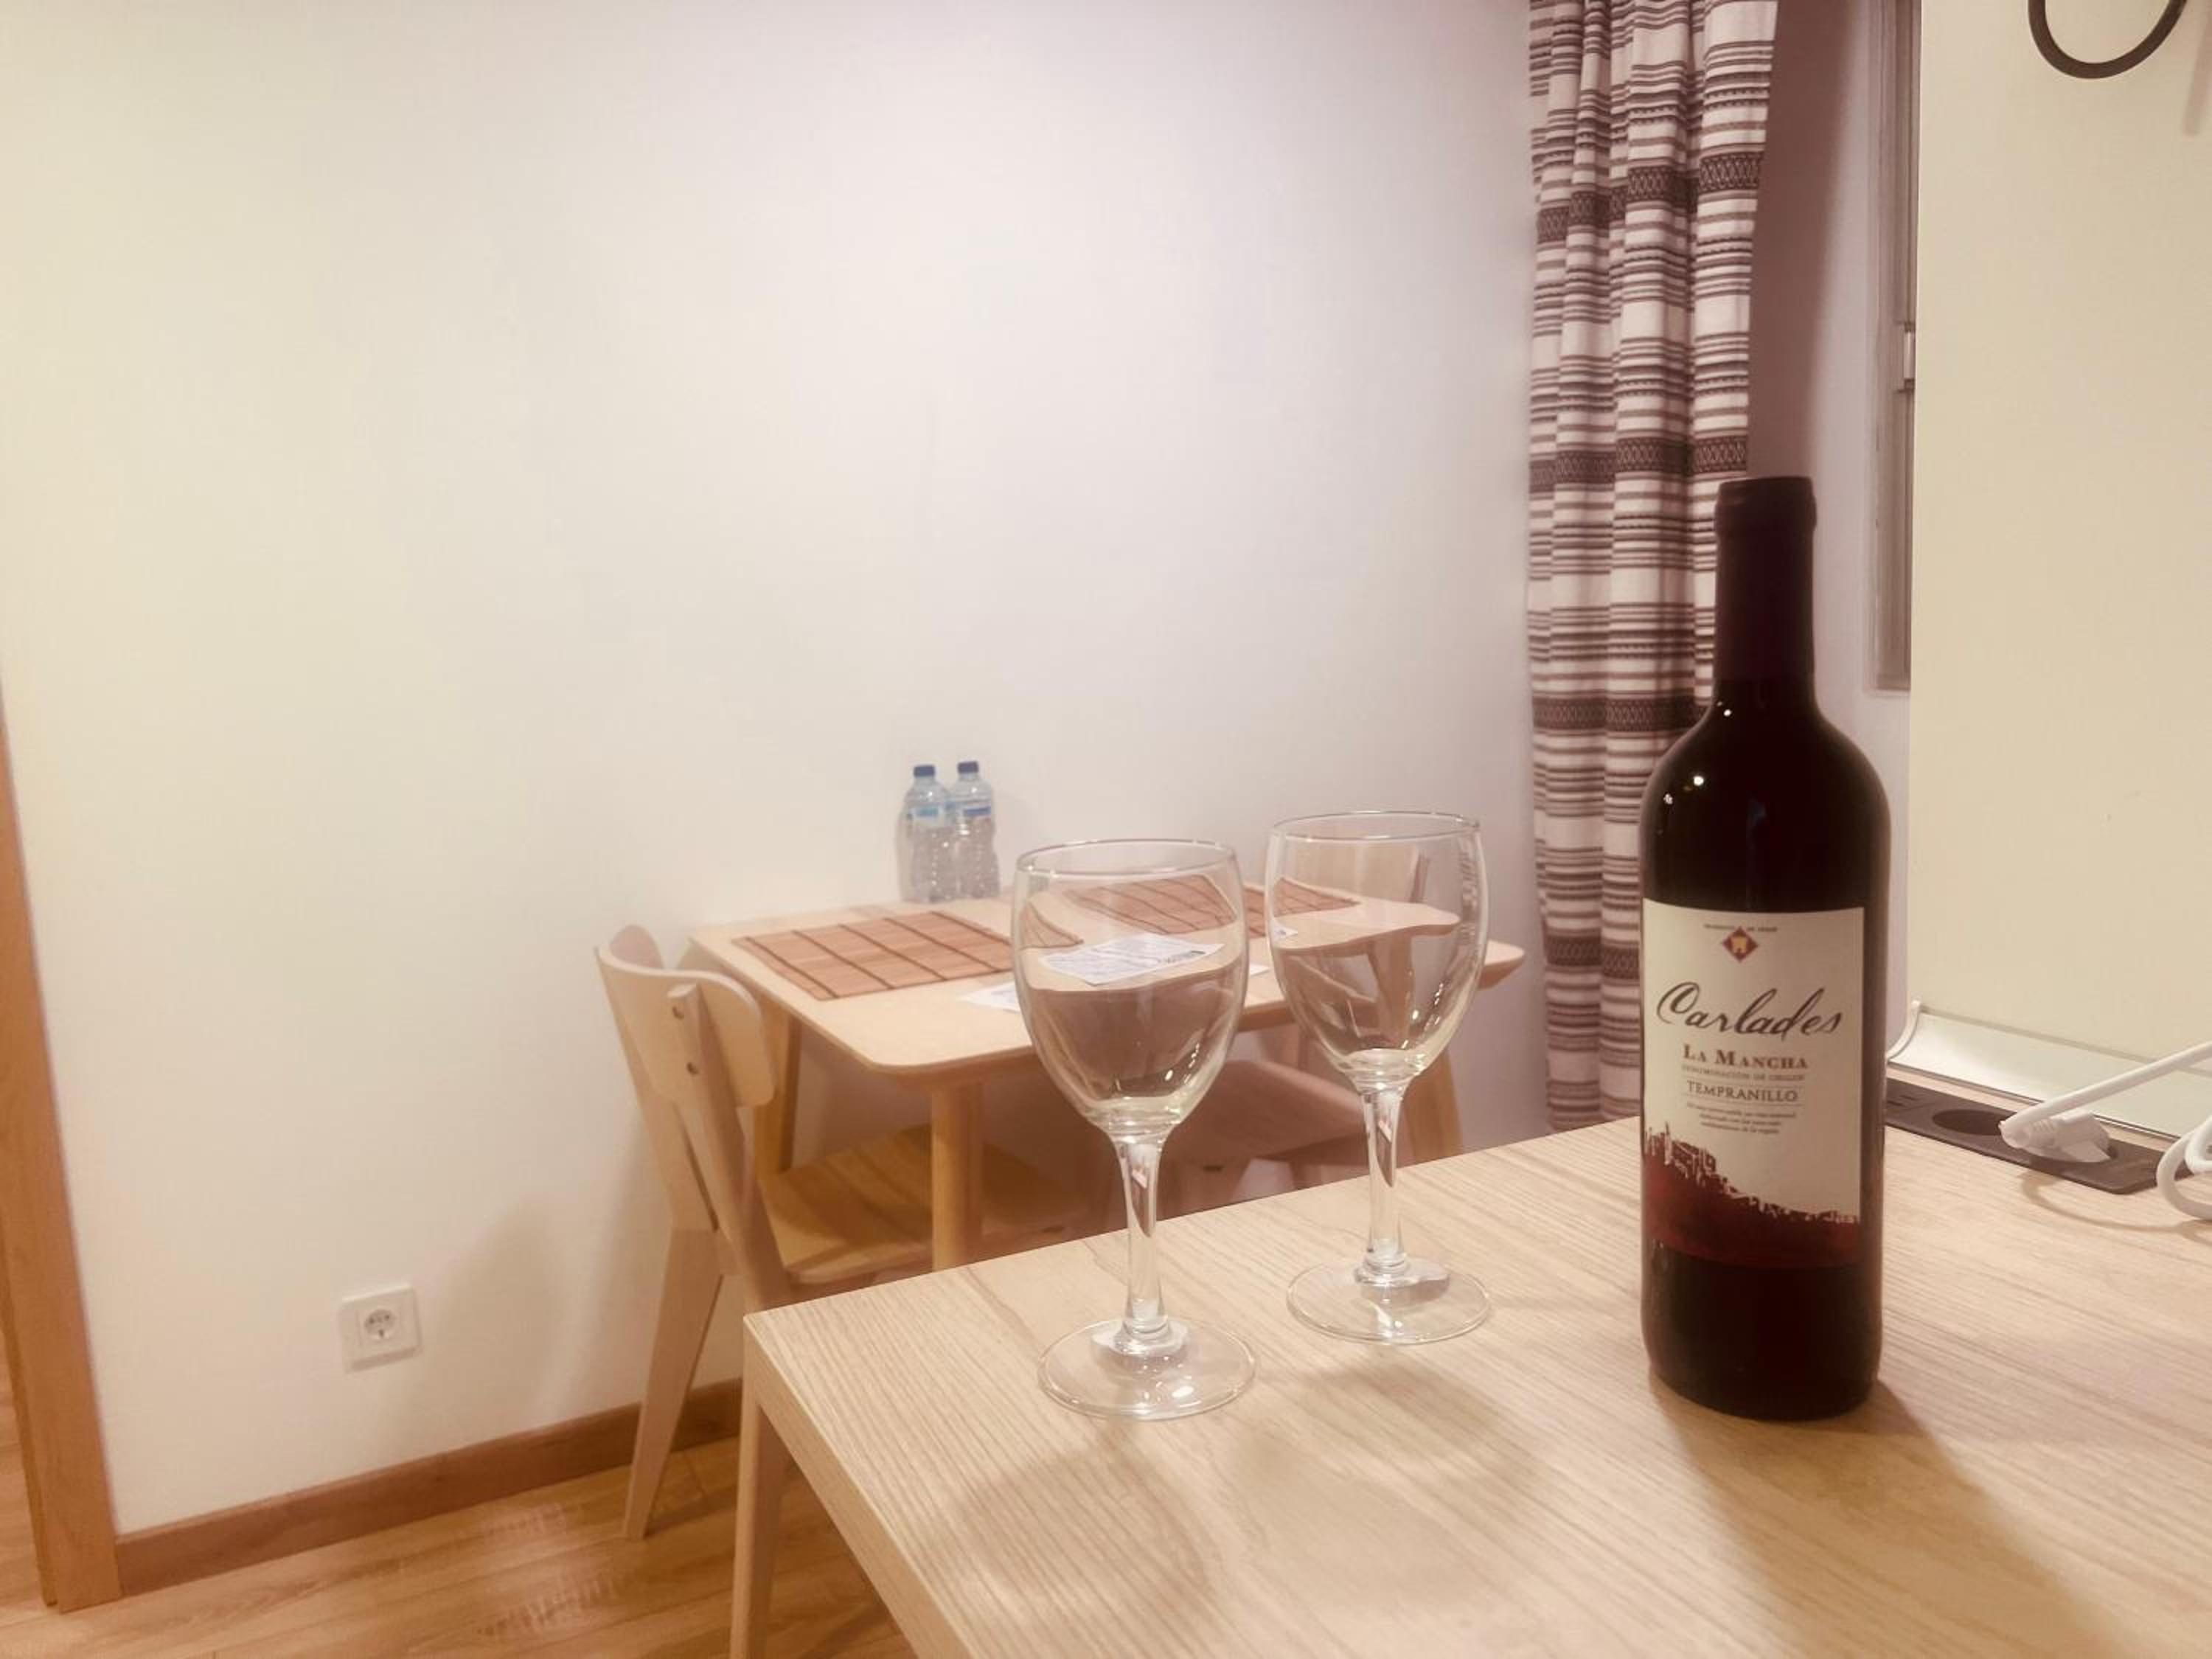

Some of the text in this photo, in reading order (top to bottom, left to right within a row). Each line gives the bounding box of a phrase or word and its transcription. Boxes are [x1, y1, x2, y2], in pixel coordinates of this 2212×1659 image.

[1657, 981, 1841, 1041] Carlades
[1683, 1043, 1808, 1068] LA MANCHA
[1687, 1080, 1798, 1102] TEMPRANILLO
